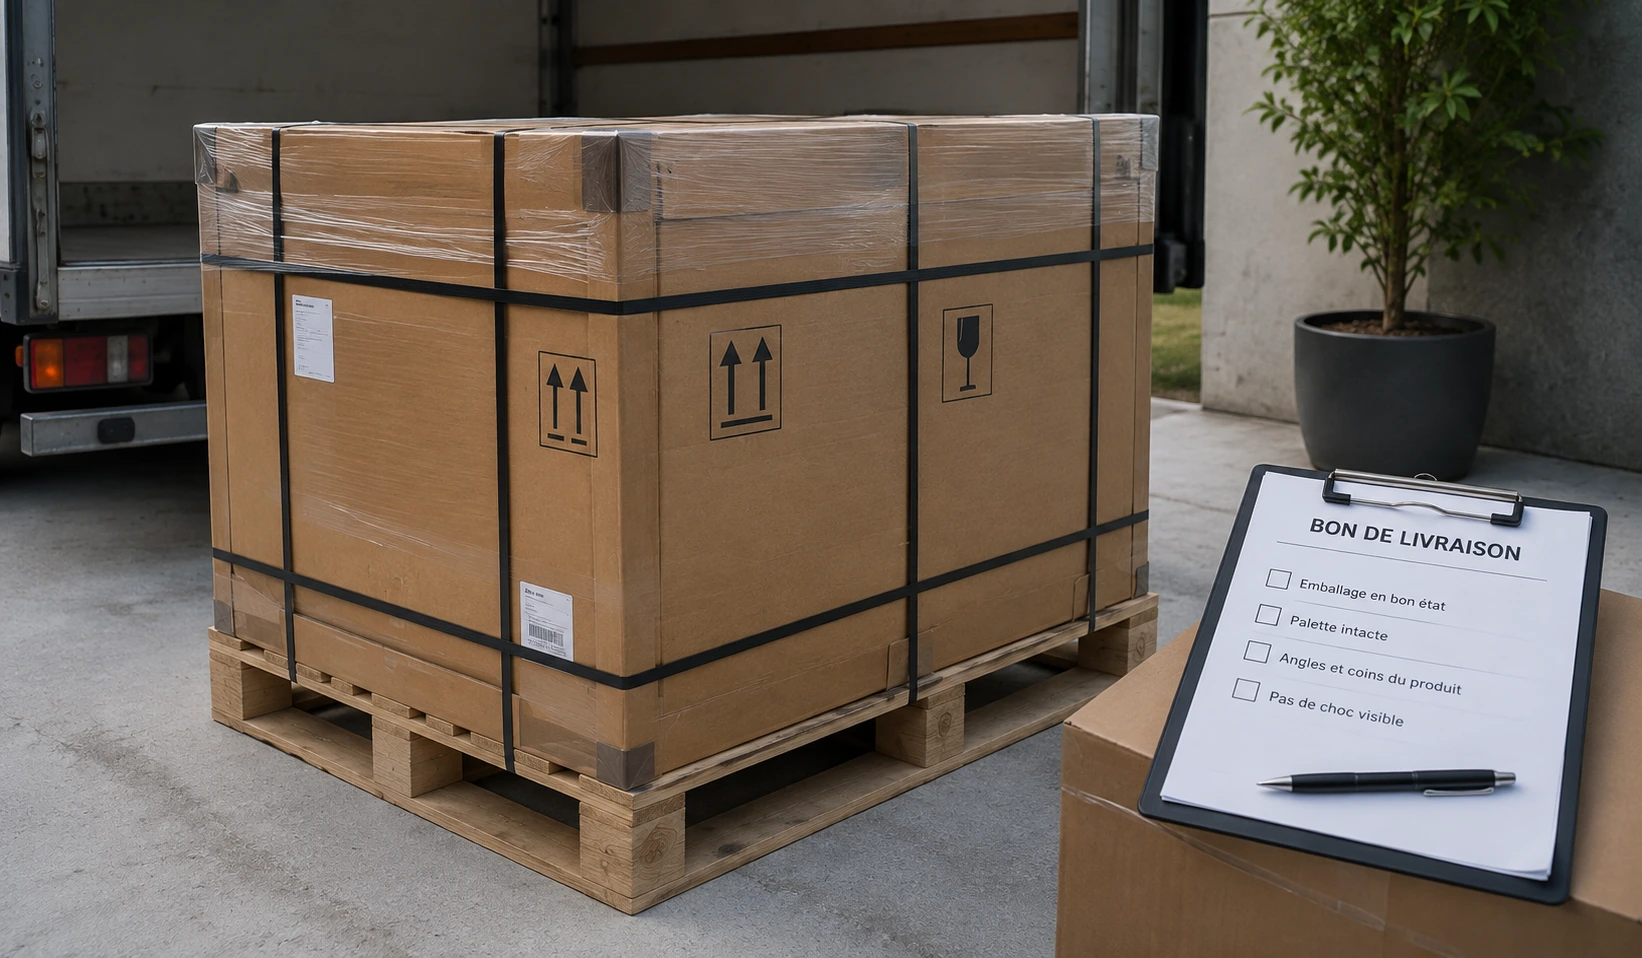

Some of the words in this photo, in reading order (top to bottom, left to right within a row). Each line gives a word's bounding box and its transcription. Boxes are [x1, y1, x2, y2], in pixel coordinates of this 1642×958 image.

[1310, 518, 1357, 538] BON
[1364, 526, 1394, 543] DE
[1400, 531, 1521, 561] LIVRAISON
[1300, 579, 1366, 599] Emballage
[1371, 593, 1386, 602] en
[1390, 594, 1415, 606] bon
[1419, 599, 1446, 611] état
[1290, 615, 1337, 632] Palette
[1341, 624, 1388, 641] intacte
[1279, 653, 1326, 670] Angles
[1330, 665, 1344, 674] et
[1348, 668, 1384, 681] coins
[1388, 674, 1406, 685] du
[1410, 680, 1462, 695] produit
[1269, 691, 1294, 705] Pas
[1299, 698, 1315, 710] de
[1320, 703, 1354, 717] choc
[1359, 710, 1404, 727] visible
